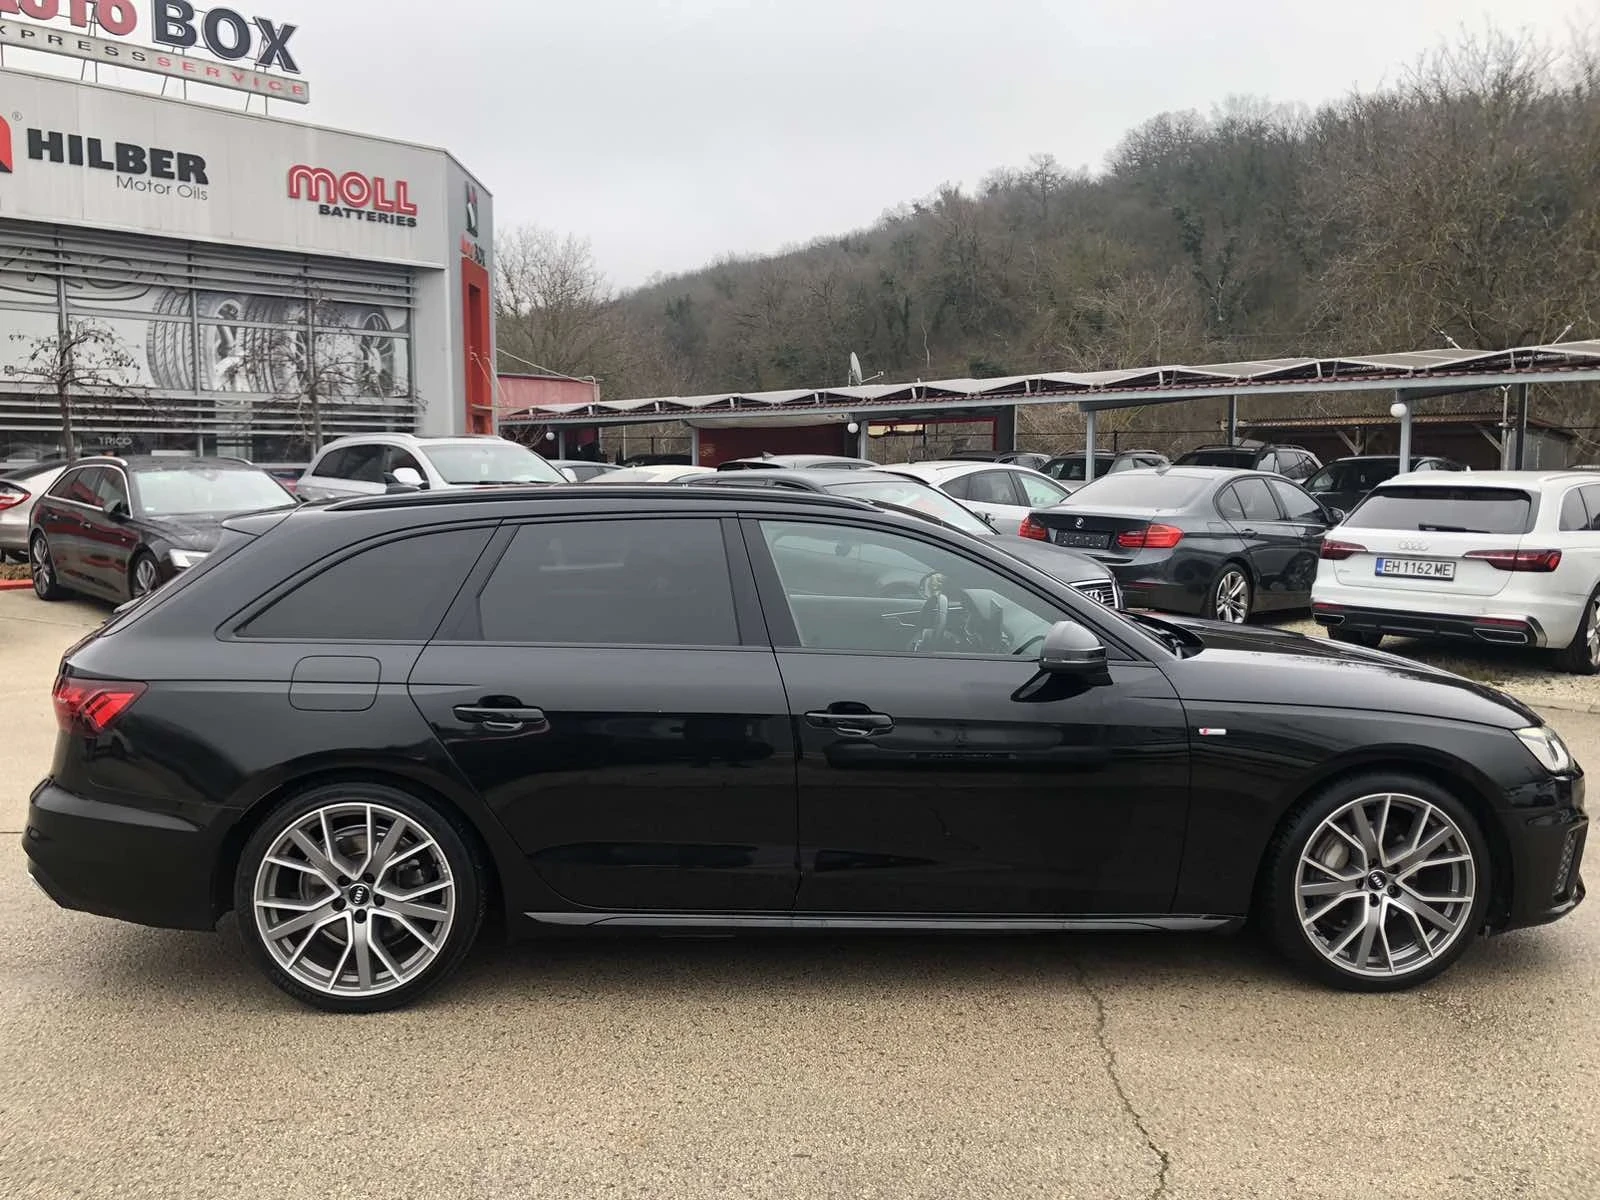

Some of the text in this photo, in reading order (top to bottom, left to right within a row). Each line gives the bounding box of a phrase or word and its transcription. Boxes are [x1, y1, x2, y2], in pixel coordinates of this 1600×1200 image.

[0, 0, 300, 74] UTO BOX
[27, 128, 209, 185] HILBER
[116, 175, 208, 201] Motor Oils
[319, 204, 417, 228] BATTERIES
